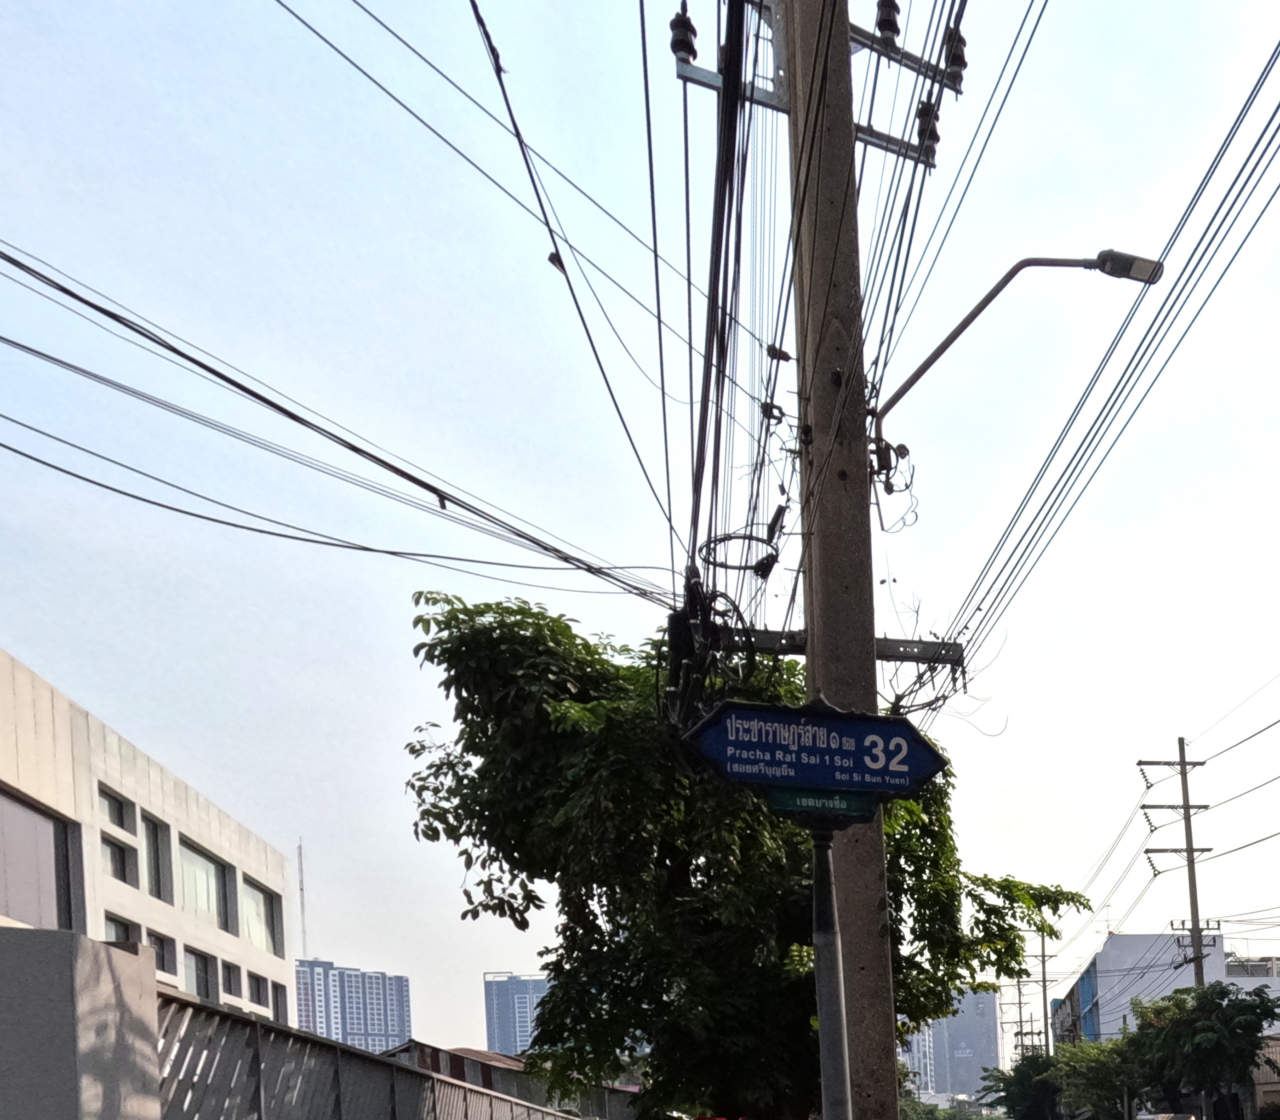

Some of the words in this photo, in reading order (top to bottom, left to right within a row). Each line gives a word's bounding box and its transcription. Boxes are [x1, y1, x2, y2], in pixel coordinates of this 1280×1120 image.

[726, 714, 828, 751] ประชาราษฎร์สาย
[842, 736, 856, 751] ซอย
[727, 746, 771, 760] Pracha
[775, 750, 797, 763] Rat
[801, 752, 820, 764] Sai
[824, 755, 830, 765] 1
[834, 756, 854, 767] Soi
[863, 734, 909, 772] 32
[835, 771, 850, 781] Soi
[853, 773, 862, 782] Si
[864, 773, 882, 783] Bun
[885, 776, 910, 786] Yuen)
